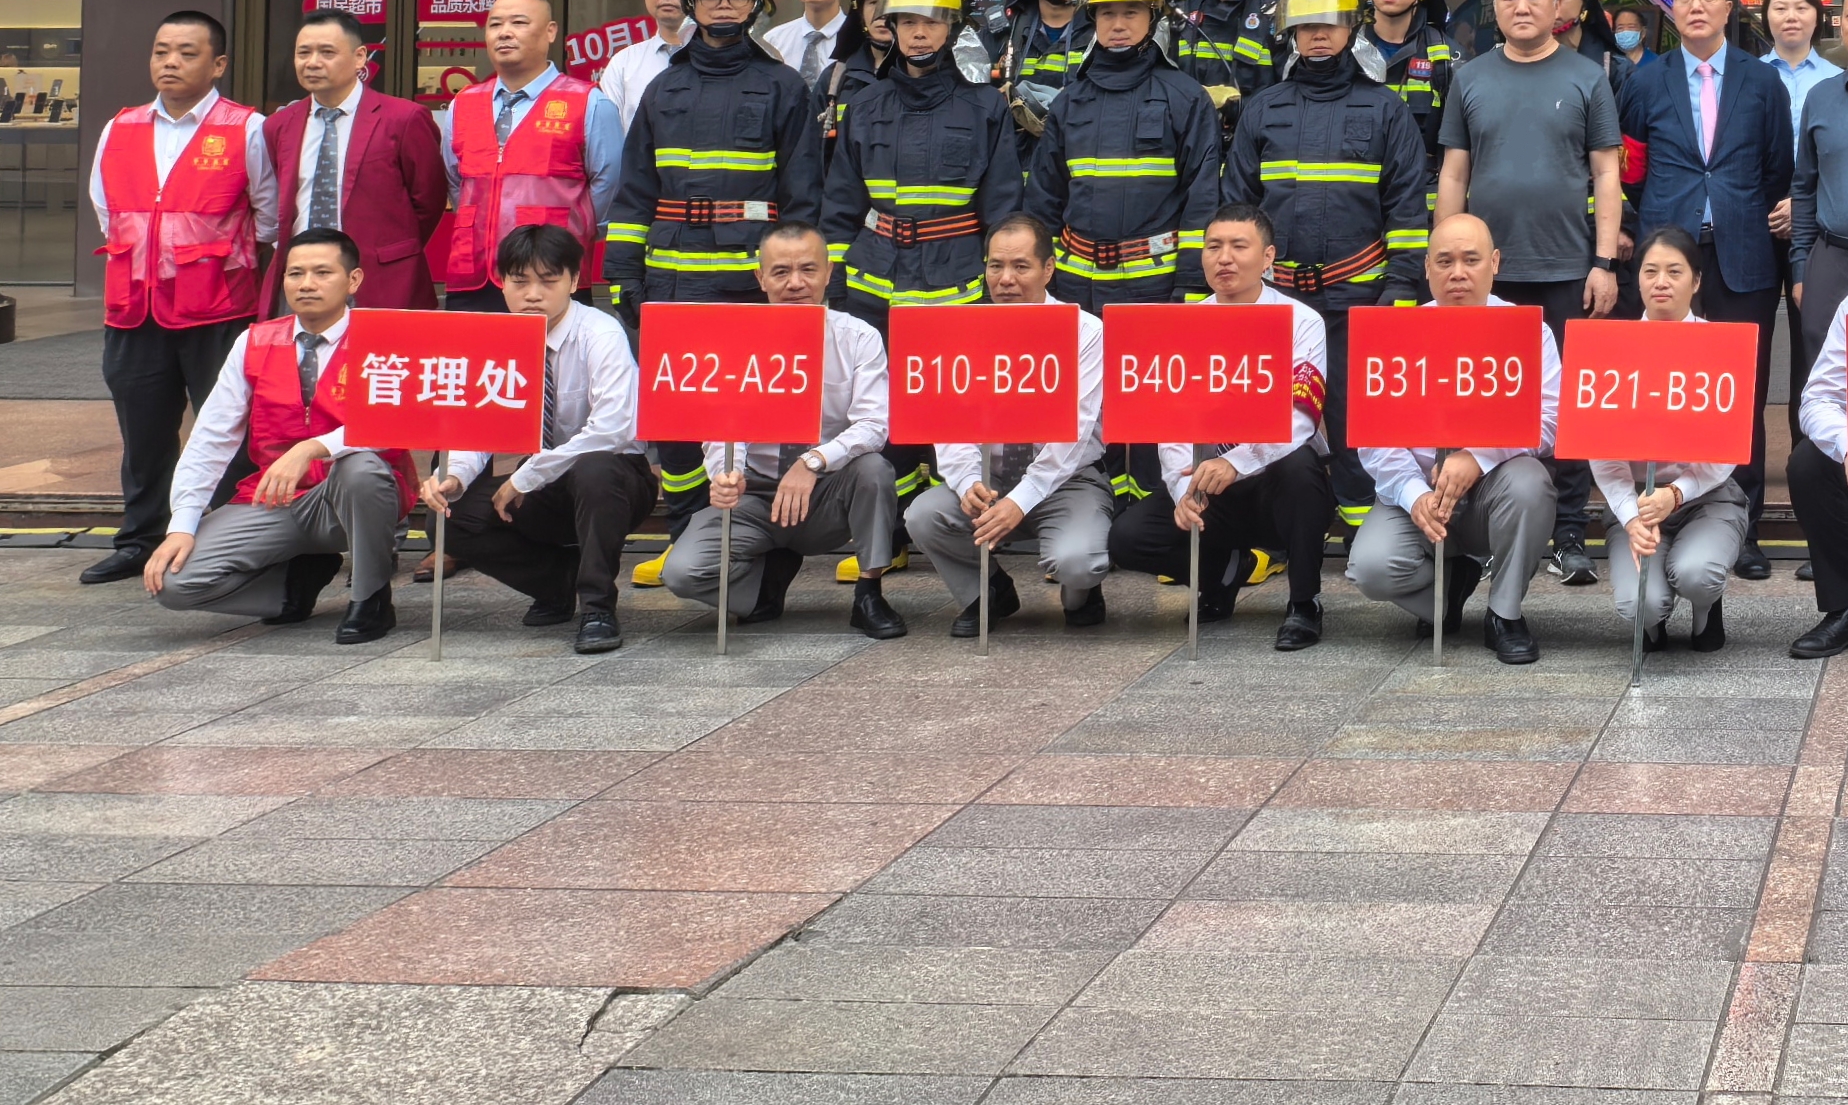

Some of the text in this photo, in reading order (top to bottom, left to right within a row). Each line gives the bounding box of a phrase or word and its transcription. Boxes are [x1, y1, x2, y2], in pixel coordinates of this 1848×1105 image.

[566, 20, 650, 66] 10月1
[360, 353, 528, 409] 管理处
[652, 352, 809, 394] A22-A25
[906, 353, 1060, 394] B10-B20
[1120, 354, 1275, 394] B40-B45
[1365, 355, 1524, 397] B31-B39
[1576, 368, 1736, 413] B21-B30
